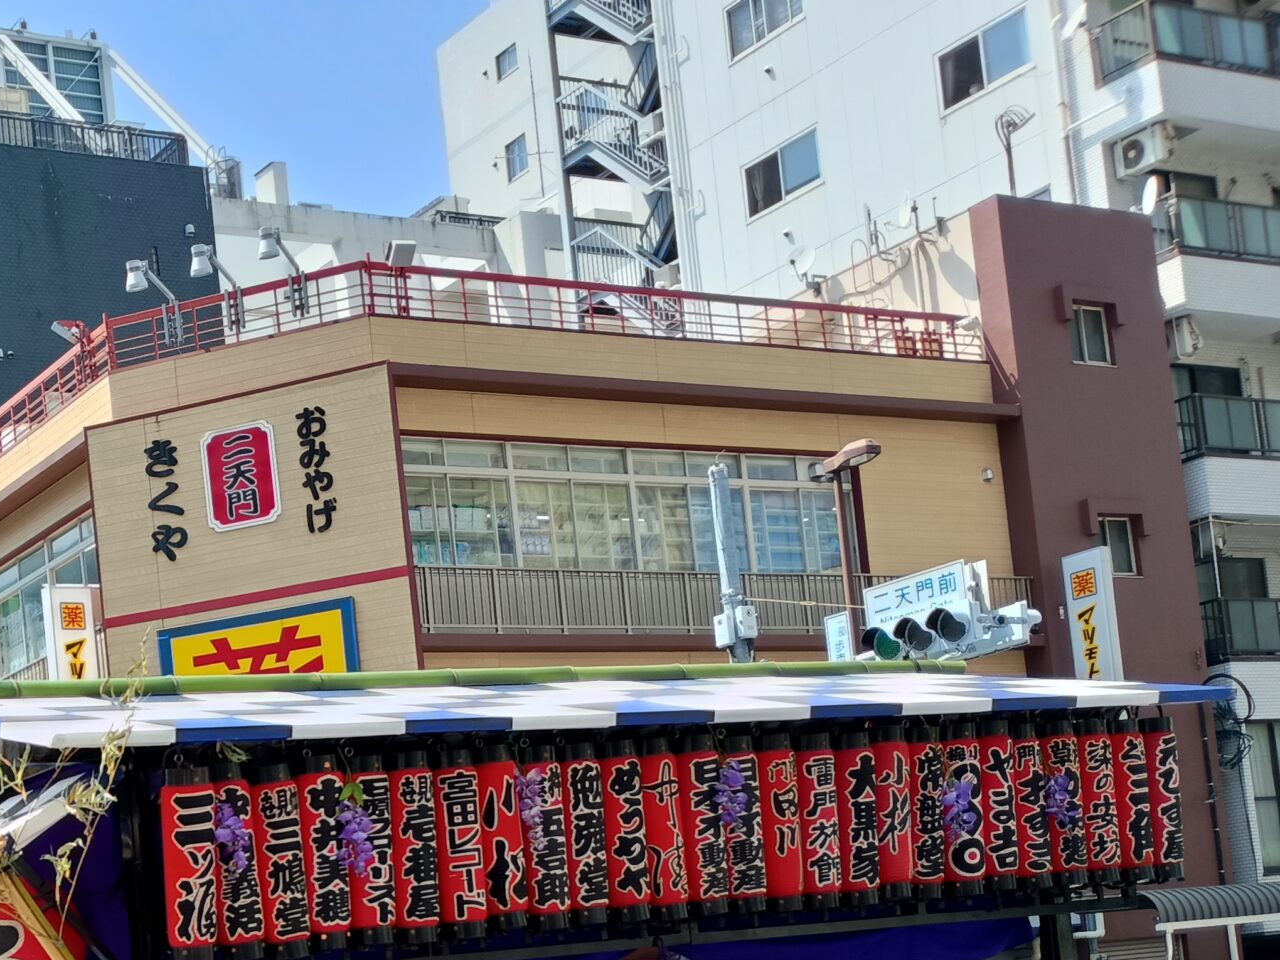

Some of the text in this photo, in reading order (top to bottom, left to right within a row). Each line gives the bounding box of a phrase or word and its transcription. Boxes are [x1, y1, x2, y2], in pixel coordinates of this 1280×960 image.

[145, 439, 188, 562] きくや
[222, 433, 260, 517] 二天門
[295, 406, 336, 534] おみやげ
[62, 605, 84, 627] 薬
[874, 570, 957, 614] 二天門前
[1073, 571, 1095, 597] 薬
[1077, 605, 1100, 680] マツモト
[437, 769, 486, 920] 宮田レコード
[568, 761, 608, 906] 勉強堂
[689, 755, 729, 899] 日本不動産
[803, 755, 841, 887] 雷門旅館
[845, 752, 880, 887] 大黒家
[1086, 738, 1121, 865] 染の安坊
